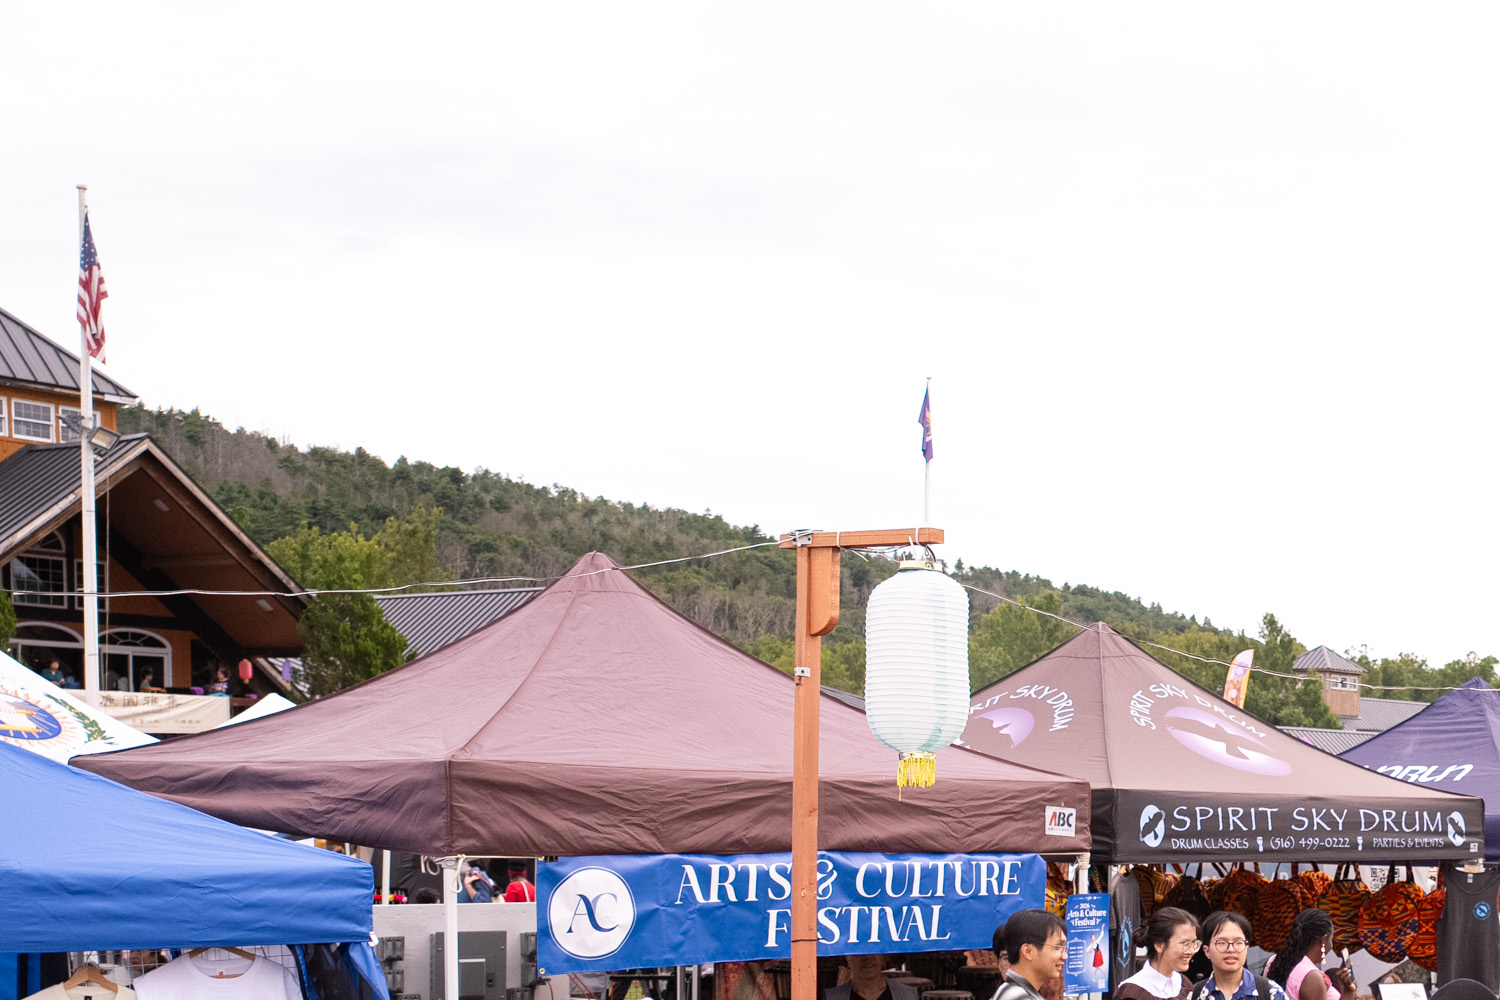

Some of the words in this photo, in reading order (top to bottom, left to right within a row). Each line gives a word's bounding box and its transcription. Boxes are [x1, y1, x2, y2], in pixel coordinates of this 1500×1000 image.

[1010, 685, 1058, 699] SKY
[1047, 692, 1074, 731] DRUM
[1129, 690, 1156, 730] SPIRIT
[1149, 683, 1189, 699] SKY
[1195, 694, 1266, 738] DRUM
[1049, 811, 1073, 828] ABC
[1171, 806, 1278, 832] SPIRIT
[1291, 808, 1348, 832] SKY
[1359, 808, 1443, 833] DRUM
[1171, 838, 1202, 850] DRUM
[1203, 837, 1249, 850] CLASSES
[1270, 836, 1295, 850] (516)
[1299, 837, 1350, 850] 499-0222
[1373, 837, 1406, 848] PARTIES
[1407, 838, 1412, 848] &
[1415, 837, 1445, 848] EVENTS
[675, 863, 792, 905] ARTS
[816, 859, 838, 900] &
[855, 861, 1022, 898] CULTURE
[566, 893, 620, 933] AC
[1067, 910, 1079, 920] Arts
[1085, 909, 1107, 917] Culture
[1075, 917, 1095, 926] Festival
[765, 905, 951, 948] FSTIVAL
